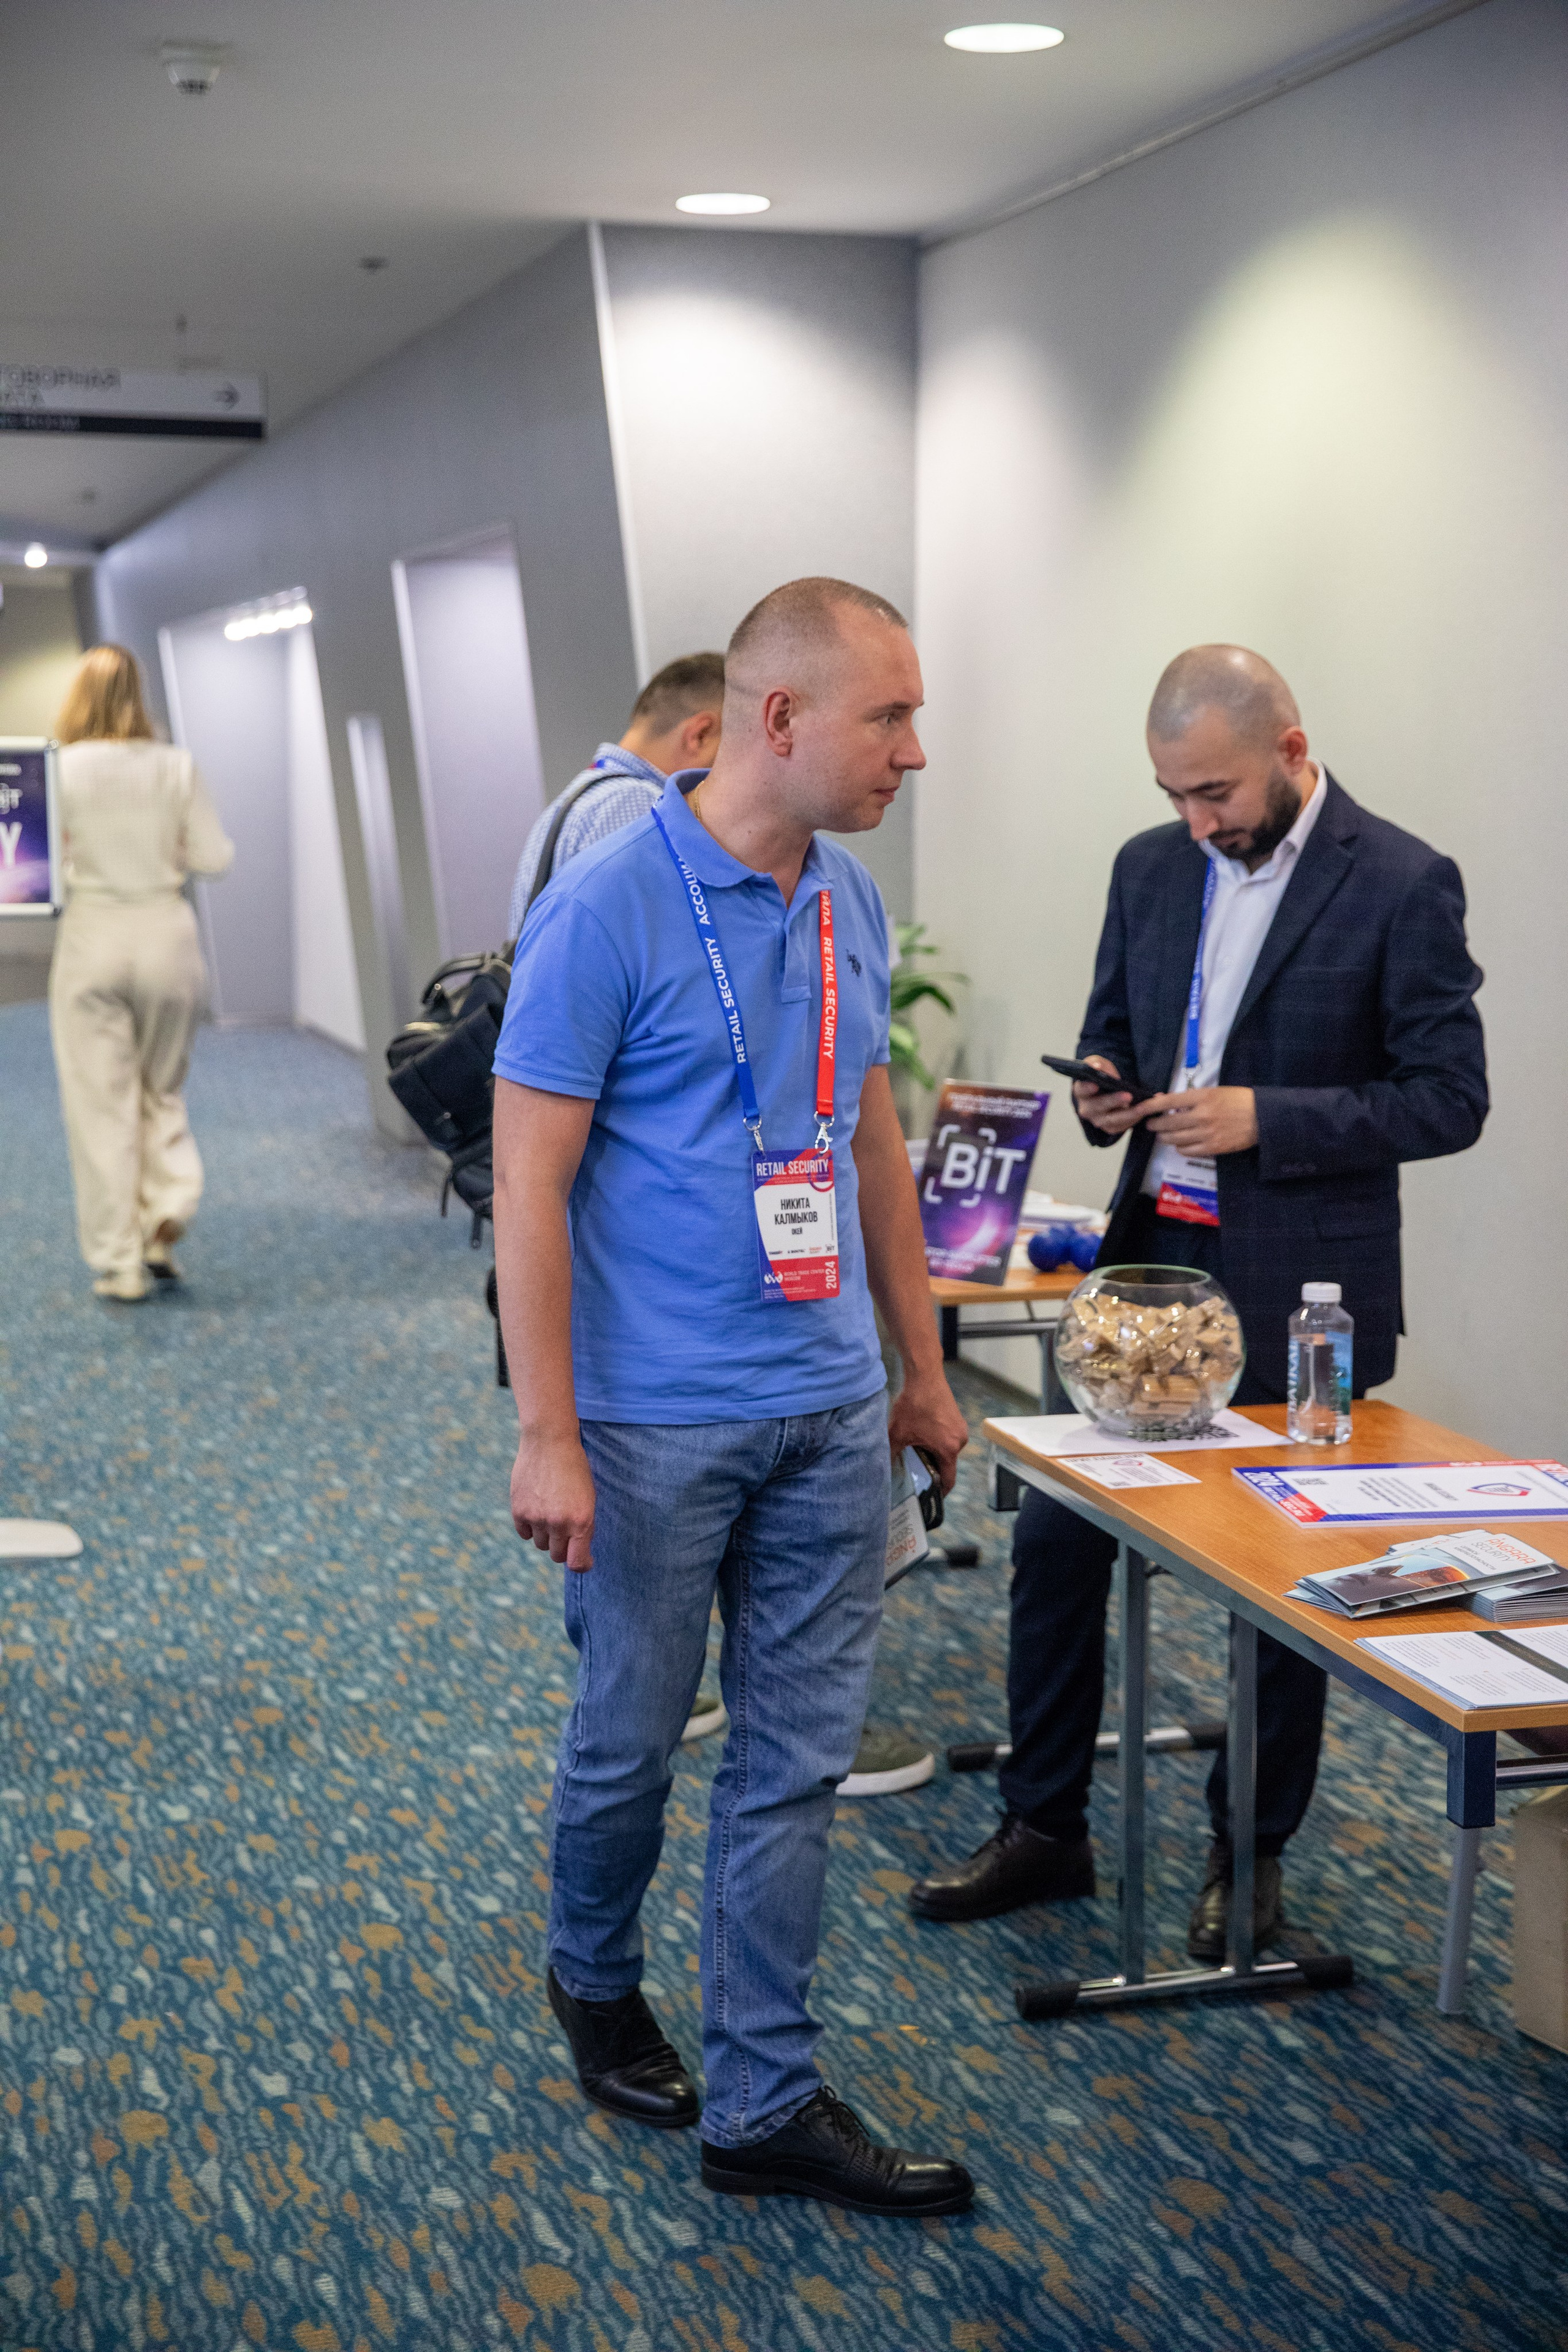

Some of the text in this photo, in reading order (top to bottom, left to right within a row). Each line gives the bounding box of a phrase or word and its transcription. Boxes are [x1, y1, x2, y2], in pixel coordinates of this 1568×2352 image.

[705, 937, 747, 1064] RETAIL SECURITY
[823, 936, 835, 1060] RETAIL SECURITY
[756, 1159, 829, 1177] RETAIL SECURITY
[780, 1197, 810, 1210] НИКИТА
[774, 1211, 818, 1225] КАЛМЫКОВ
[824, 1261, 837, 1289] 2024
[1243, 1471, 1285, 1487] 2024
